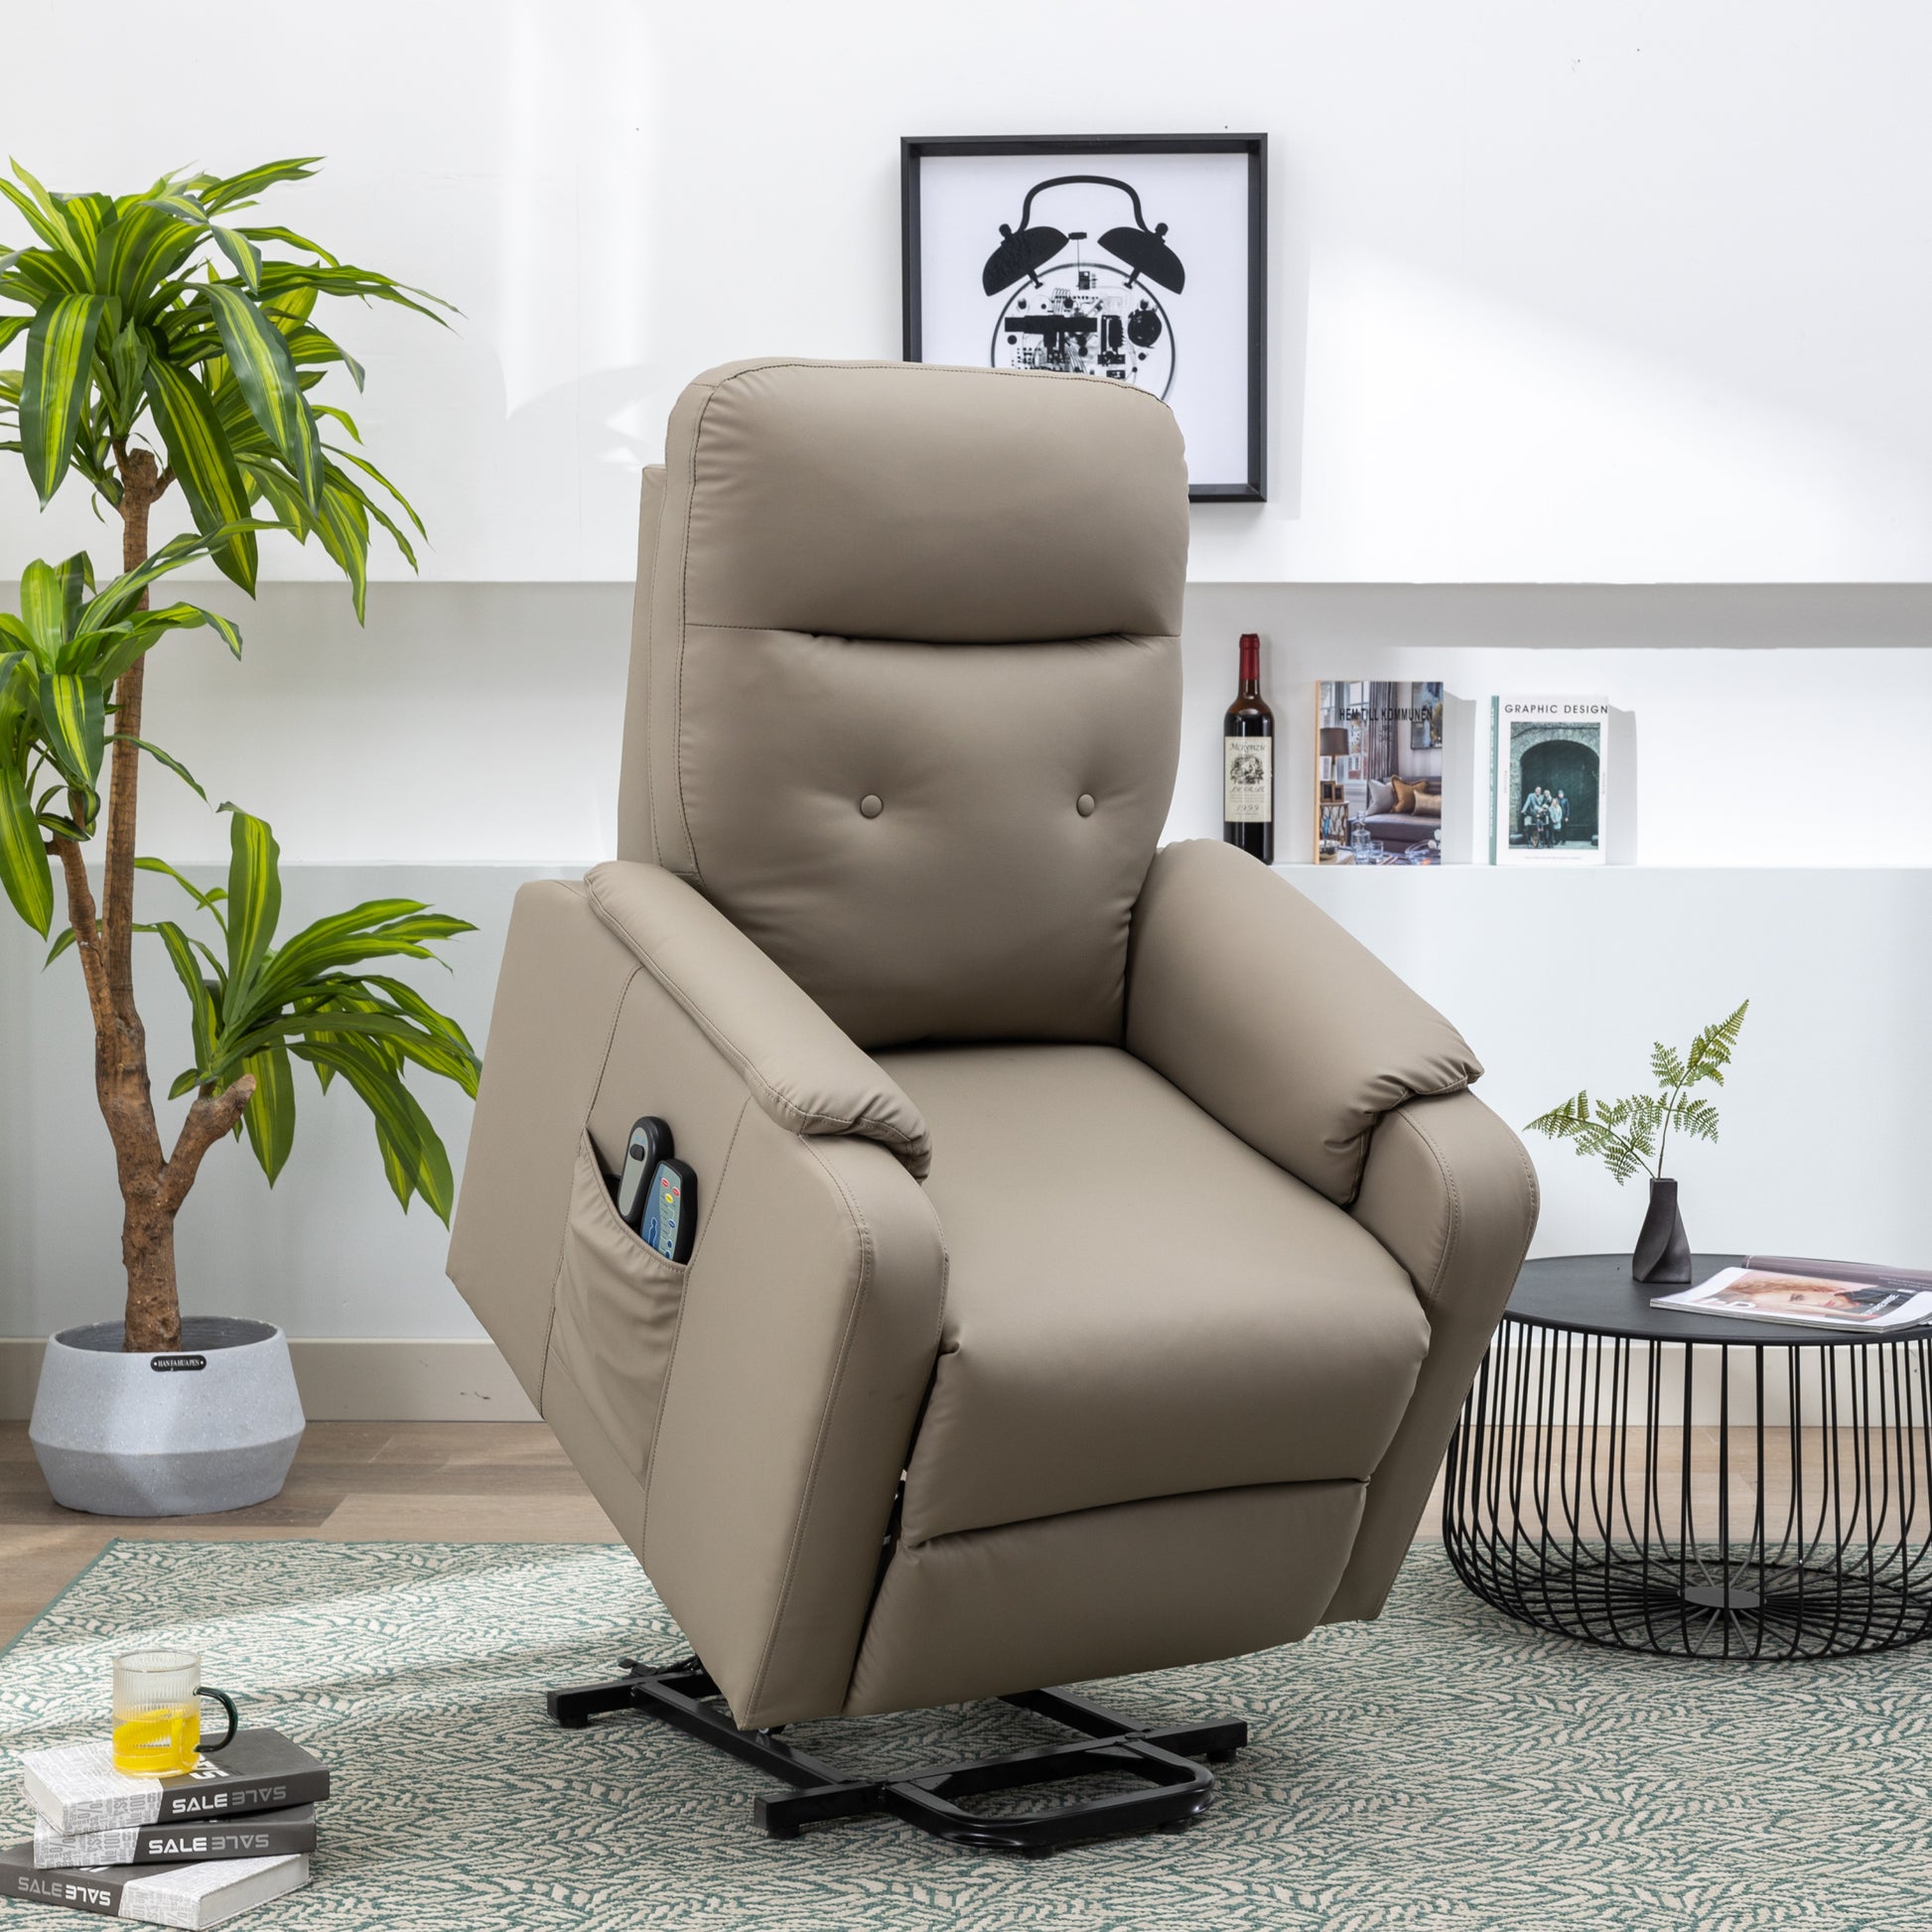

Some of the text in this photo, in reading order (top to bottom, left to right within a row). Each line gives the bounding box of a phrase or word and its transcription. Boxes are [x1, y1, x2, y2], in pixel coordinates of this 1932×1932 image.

[1381, 706, 1434, 722] KOMMUNEN
[1504, 704, 1608, 715] GRAPHIC DESIGN
[172, 1792, 228, 1815] SALE
[148, 1836, 207, 1855] SALE
[17, 1875, 63, 1898] SALE
